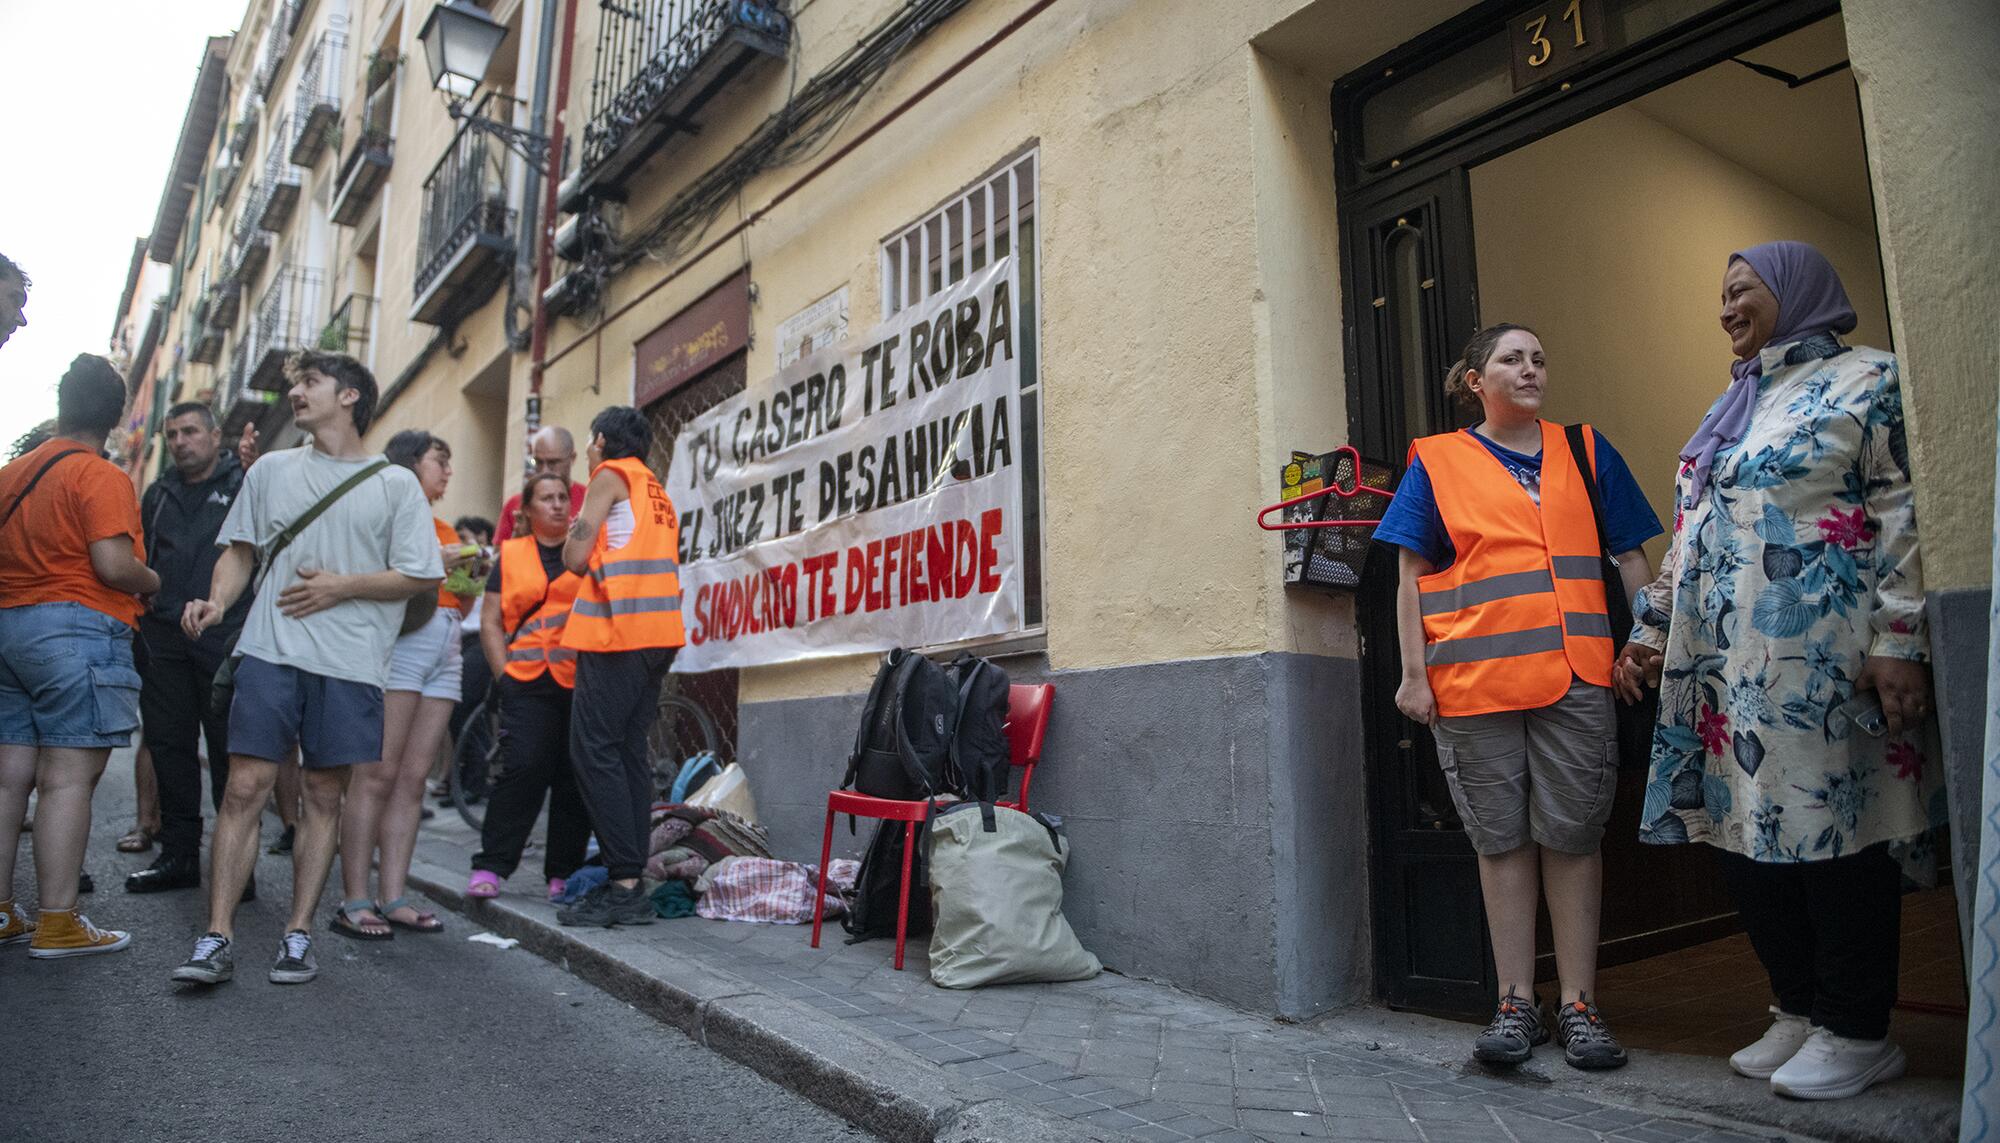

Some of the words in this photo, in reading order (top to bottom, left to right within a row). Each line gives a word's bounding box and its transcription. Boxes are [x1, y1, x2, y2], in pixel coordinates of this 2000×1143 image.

[1524, 0, 1587, 67] 31
[688, 422, 721, 490] TU
[731, 362, 846, 468] CASERO
[860, 333, 901, 418] TE
[907, 279, 1014, 400] ROBA
[678, 507, 704, 565] EL
[709, 483, 765, 558] JUEZ
[772, 468, 806, 538] TE
[818, 395, 1012, 523] DESAHUCIA
[691, 562, 798, 646] SINDICATO
[802, 551, 839, 624] TE
[844, 507, 1003, 615] DEFIENDE
